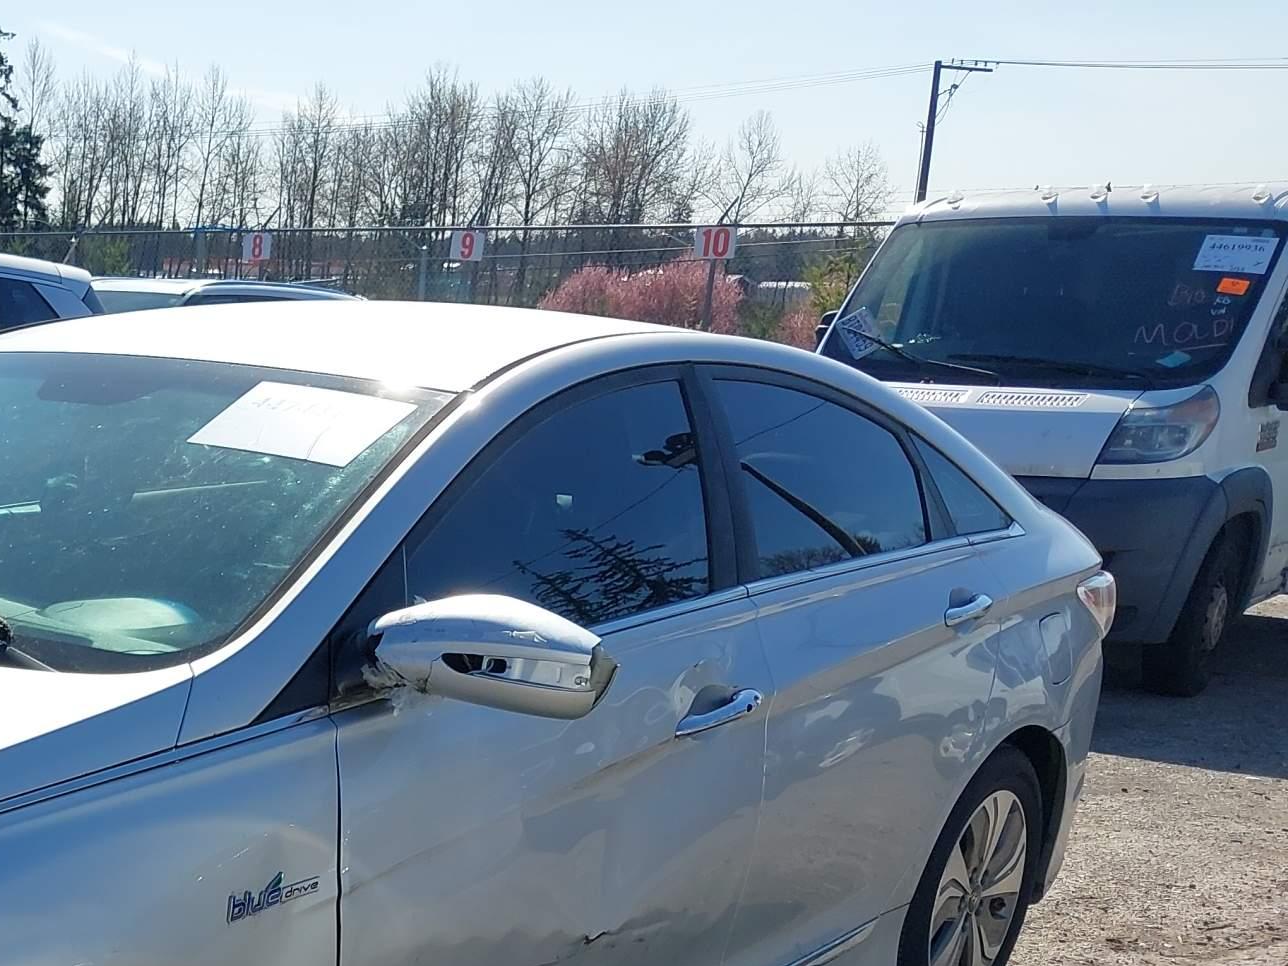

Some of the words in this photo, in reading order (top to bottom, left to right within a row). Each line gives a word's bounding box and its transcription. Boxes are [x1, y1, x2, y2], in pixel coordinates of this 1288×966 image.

[252, 235, 263, 258] 8
[461, 232, 474, 259] 9
[702, 229, 730, 258] 10
[226, 886, 282, 924] blue
[284, 881, 319, 899] drive
